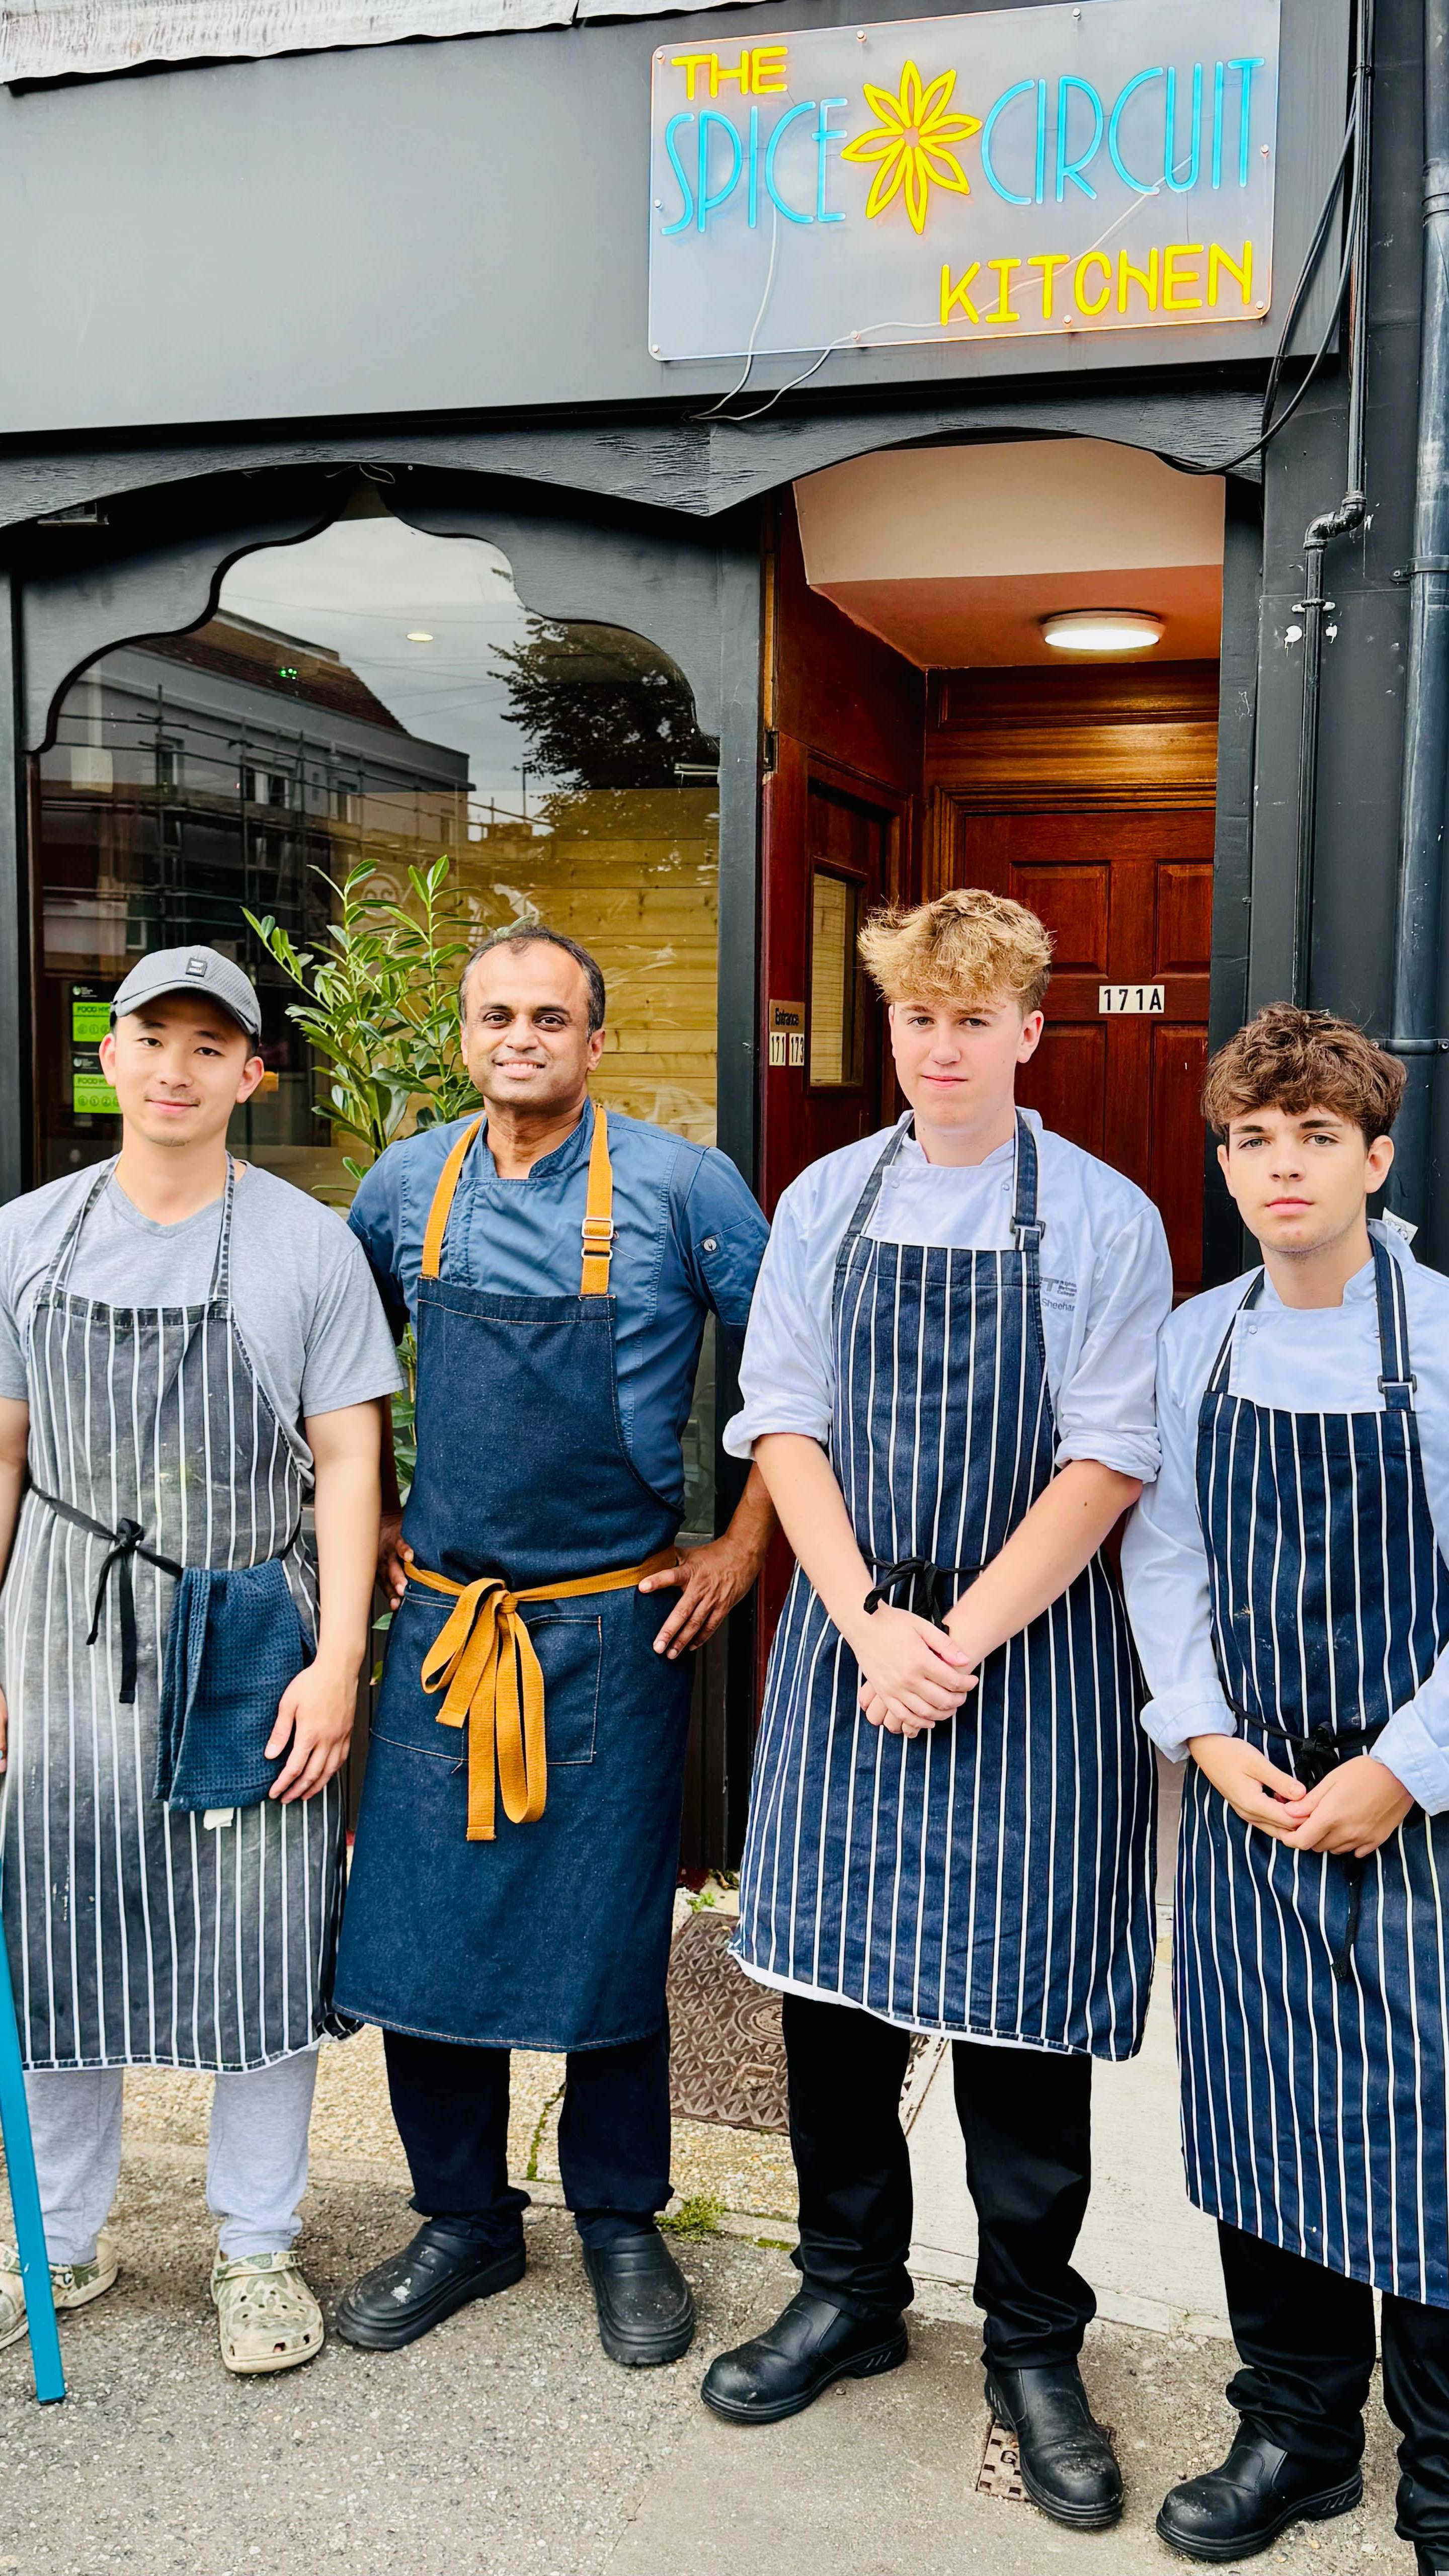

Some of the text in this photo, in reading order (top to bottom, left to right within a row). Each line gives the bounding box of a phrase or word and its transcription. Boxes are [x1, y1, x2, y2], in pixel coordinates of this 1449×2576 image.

[671, 46, 788, 100] THE
[662, 57, 1265, 234] SPICE CIRCUIT
[940, 241, 1253, 327] KITCHEN
[1104, 988, 1162, 1011] 171A
[775, 1007, 799, 1026] Entrance
[771, 1035, 784, 1063] 171
[790, 1036, 803, 1063] 173
[1000, 2450, 1018, 2465] G
